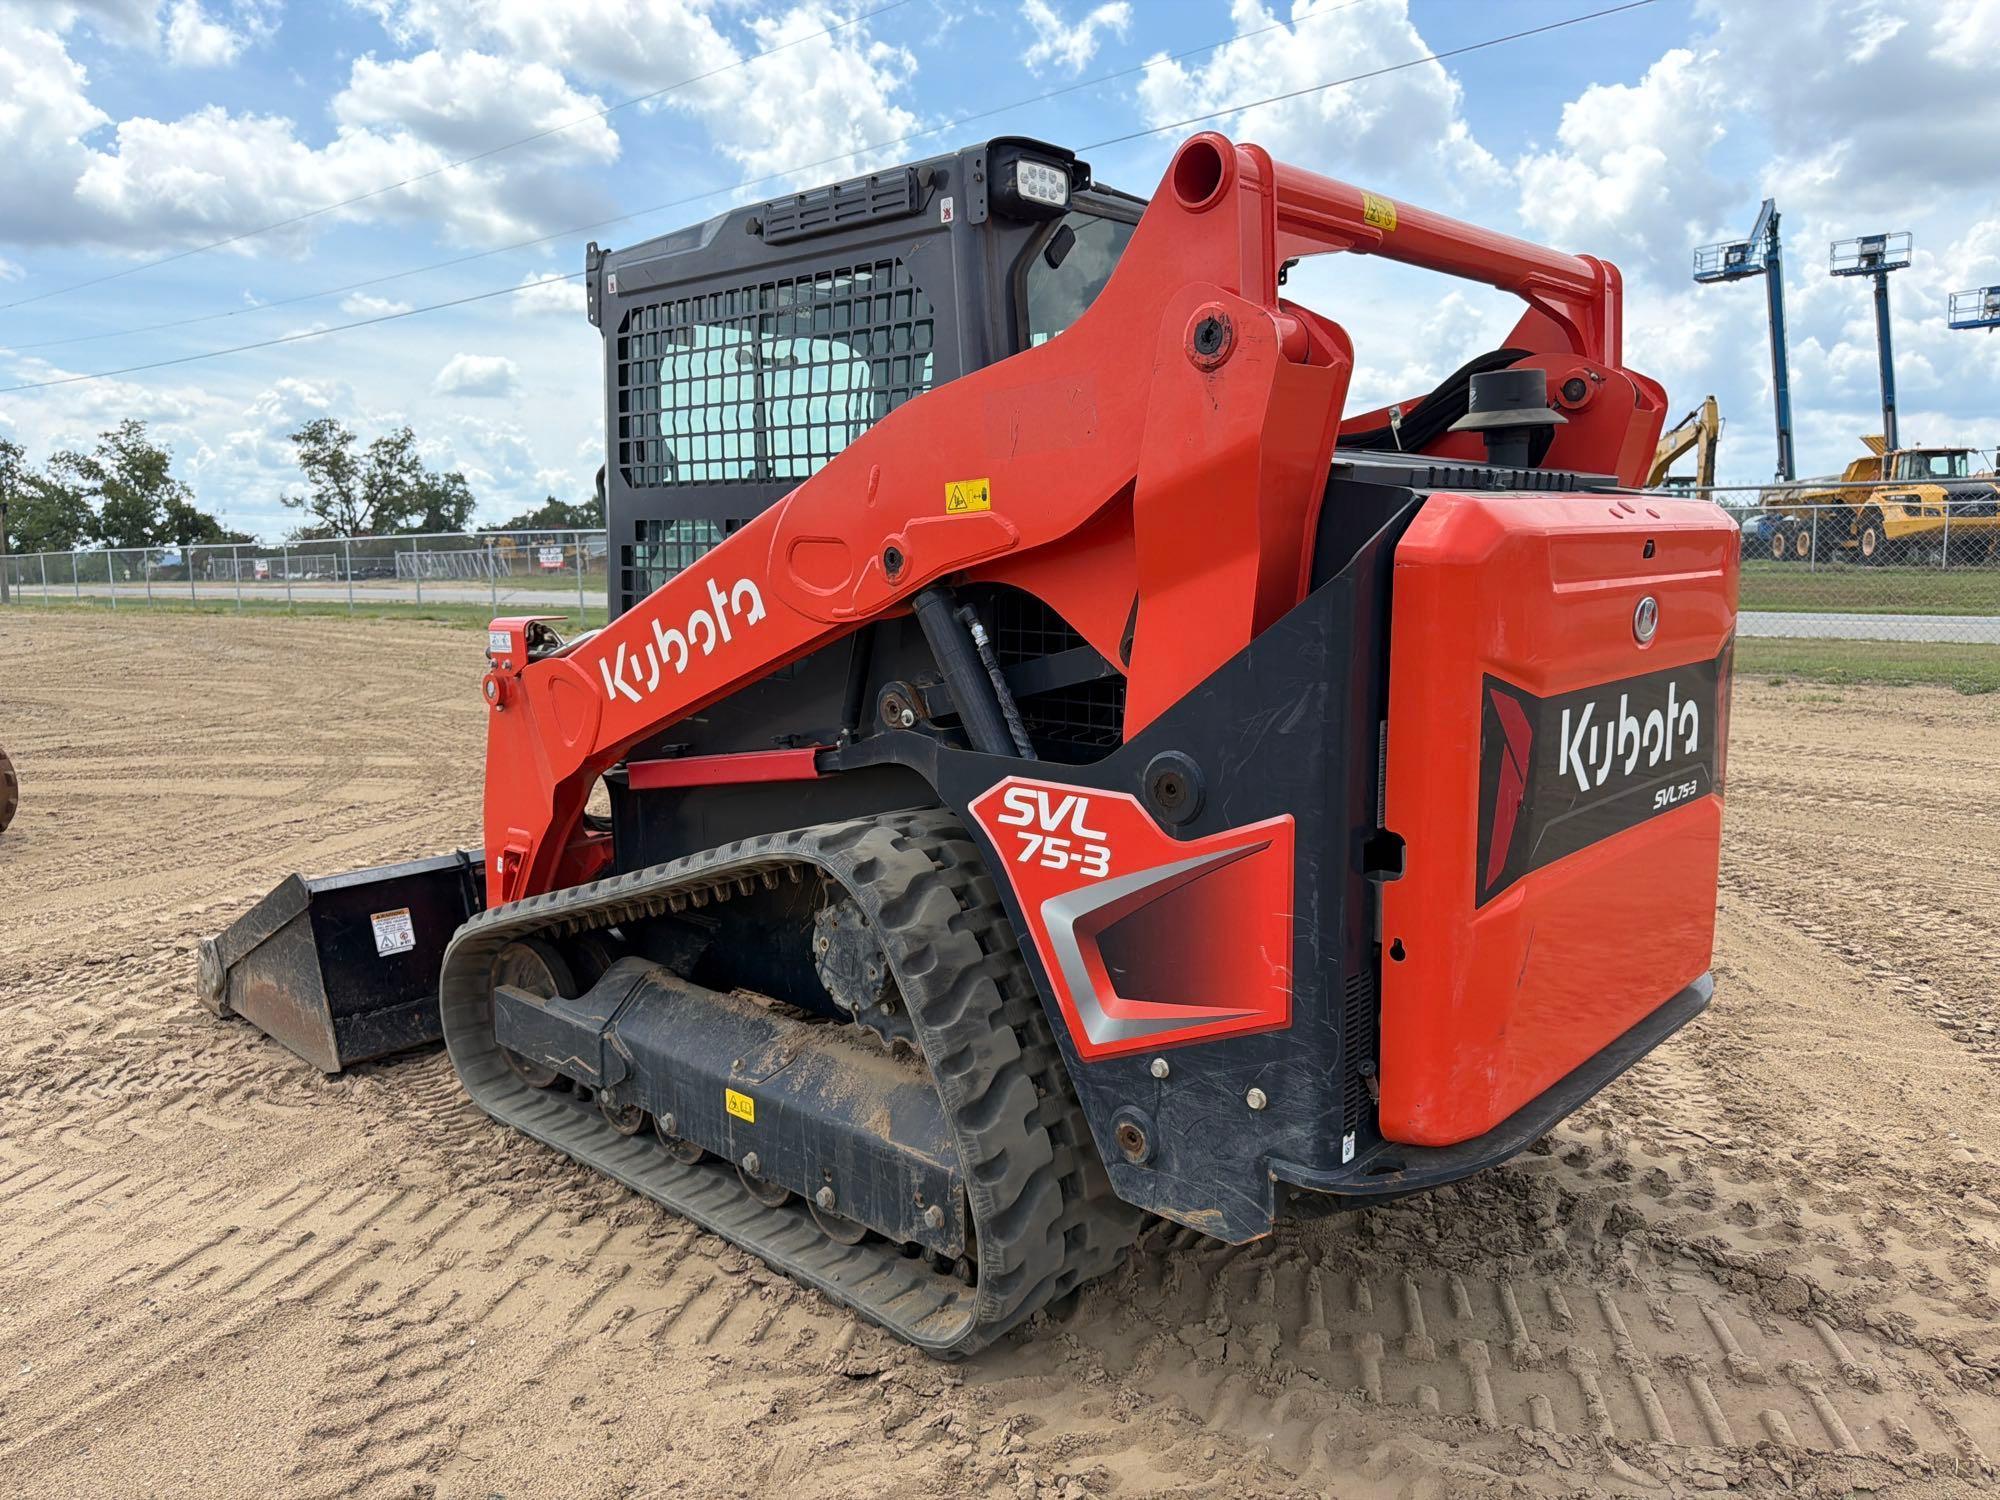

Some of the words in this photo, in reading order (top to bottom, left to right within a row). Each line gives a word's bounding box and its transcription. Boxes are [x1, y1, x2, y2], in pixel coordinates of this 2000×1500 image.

[599, 578, 766, 703] Kubota
[1559, 681, 1699, 792] Kubota
[998, 788, 1107, 840] SVL
[1017, 832, 1111, 878] 75-3
